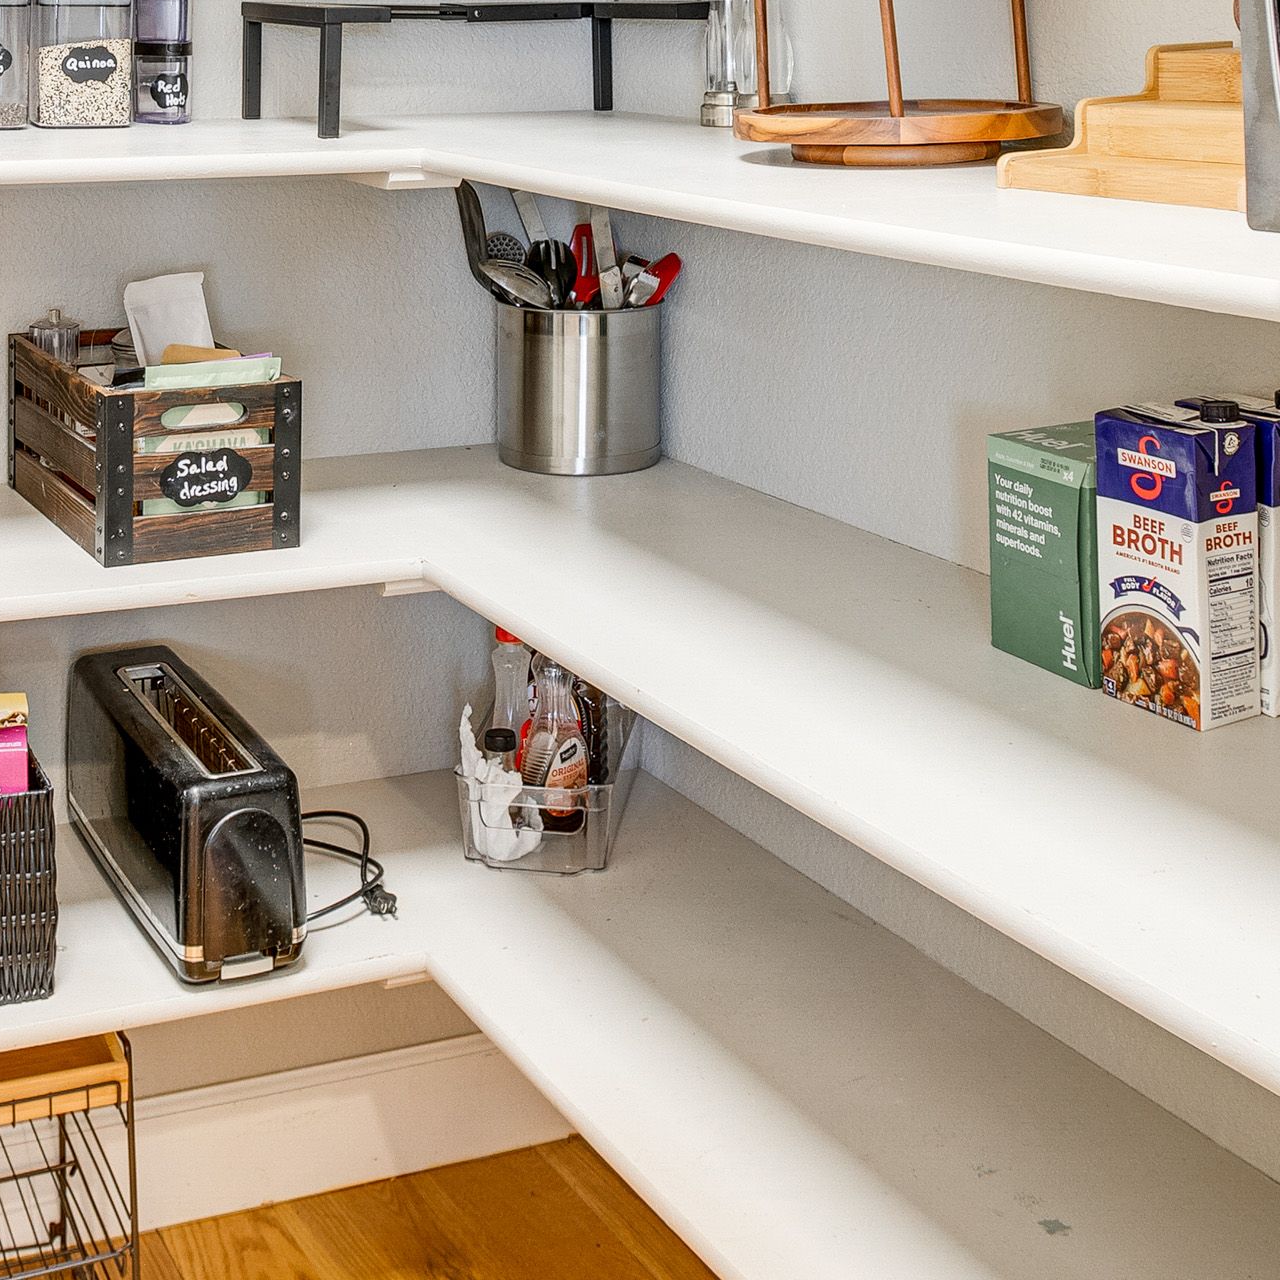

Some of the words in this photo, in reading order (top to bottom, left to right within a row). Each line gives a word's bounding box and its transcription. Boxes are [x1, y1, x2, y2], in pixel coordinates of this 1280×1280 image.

[65, 57, 116, 71] Quinoa
[157, 81, 180, 93] Red
[177, 455, 229, 479] Salad
[1121, 451, 1173, 475] SWANSON
[180, 473, 238, 500] dressing
[994, 473, 1013, 489] Your
[1013, 481, 1034, 498] daily
[1063, 471, 1074, 482] x4
[995, 489, 1028, 510] nutrition
[1028, 500, 1053, 519] boost
[1210, 490, 1239, 500] SWANSON
[995, 502, 1012, 519] with
[1012, 508, 1023, 523] 42
[1023, 513, 1062, 538] vitamins,
[995, 517, 1029, 540] minerals
[1029, 531, 1046, 546] and
[1133, 514, 1165, 536] BEEF
[1215, 521, 1239, 534] BEEF
[995, 532, 1043, 559] superfoods.
[1112, 524, 1183, 565] BROTH
[1205, 530, 1252, 552] BROTH
[1115, 550, 1141, 565] AMERICA'S
[1148, 559, 1164, 570] BROTH
[1164, 564, 1180, 575] BRAND
[1207, 556, 1235, 567] Nutrition
[1235, 552, 1253, 562] Facts
[1121, 582, 1140, 590] BODY
[1152, 587, 1177, 609] FLAVOR
[1209, 585, 1232, 595] Calories
[1245, 577, 1254, 587] 10
[1059, 610, 1077, 671] Huel
[551, 759, 585, 778] ORIGINAL
